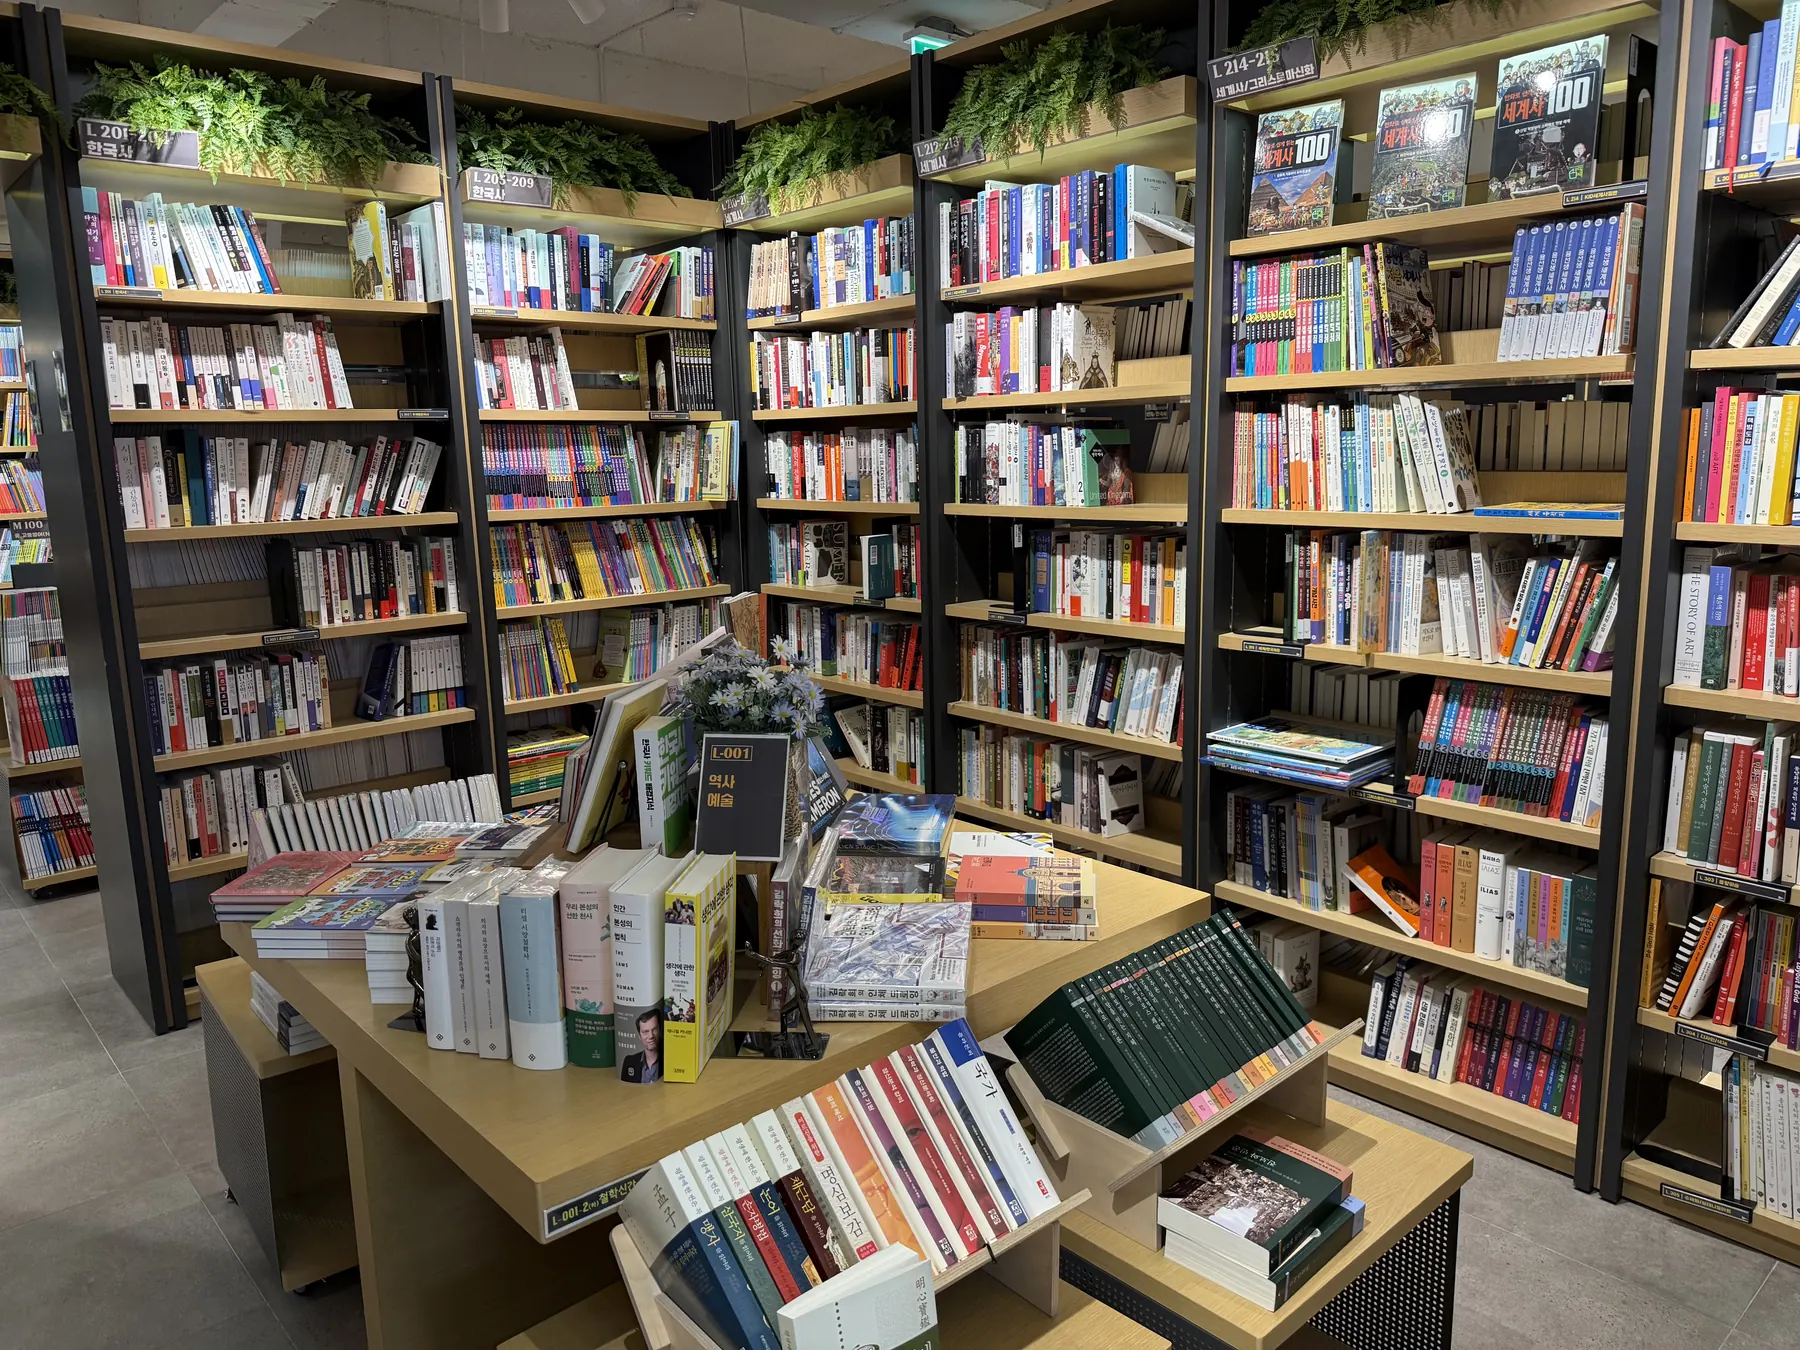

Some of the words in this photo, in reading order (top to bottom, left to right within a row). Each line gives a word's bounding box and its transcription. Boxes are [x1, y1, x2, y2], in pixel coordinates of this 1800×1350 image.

[1212, 64, 1222, 79] L
[1503, 98, 1544, 123] 세계사
[1547, 77, 1589, 115] 100
[86, 124, 97, 136] L
[86, 141, 134, 158] 한국사
[916, 146, 924, 157] L
[1263, 149, 1294, 169] 세계사
[1296, 133, 1330, 164] 100
[919, 155, 947, 173] 세계사
[474, 172, 481, 182] L
[472, 186, 506, 200] 한국사
[1078, 481, 1083, 492] 2
[1089, 491, 1106, 500] United
[1107, 491, 1131, 501] Kingdom
[12, 521, 23, 530] M
[24, 520, 43, 530] 100
[833, 524, 845, 582] SUMER
[1690, 564, 1701, 585] THE
[1687, 587, 1699, 619] STORY
[1686, 621, 1696, 635] OF
[1684, 637, 1695, 656] ART
[642, 738, 651, 759] 한국사
[713, 747, 749, 759] L-001
[644, 760, 652, 782] 키워드
[709, 775, 735, 789] 역사
[645, 782, 654, 810] 배경지식
[707, 793, 734, 807] 예술
[811, 787, 840, 824] AMERON
[1480, 887, 1499, 896] ILIAS
[520, 908, 527, 921] 러셀
[566, 903, 578, 911] 우리
[579, 903, 599, 911] 본성의
[613, 904, 626, 913] 인간
[566, 912, 579, 920] 선한
[580, 912, 592, 920] 천사
[613, 919, 633, 928] 본성의
[614, 933, 627, 942] 법칙
[665, 962, 682, 970] 생각에
[683, 962, 695, 971] 관한
[827, 1006, 864, 1019] 김락희의
[868, 1009, 887, 1018] 인체
[890, 1009, 919, 1018] 드로잉
[881, 1066, 898, 1091] 정신분석
[893, 1090, 904, 1103] 강의
[969, 1060, 999, 1101] 국가
[853, 1078, 868, 1099] 종교의
[864, 1098, 875, 1111] 기원
[825, 1094, 836, 1108] 꿈의
[832, 1107, 843, 1121] 해석
[733, 1136, 749, 1158] 평생에
[747, 1162, 759, 1177] 번은
[755, 1186, 780, 1216] 논어
[764, 1124, 781, 1145] 평생에
[778, 1150, 791, 1165] 번은
[786, 1173, 817, 1215] 채근담
[694, 1154, 711, 1175] 평생에
[708, 1180, 722, 1196] 번은
[718, 1204, 746, 1241] 삼국지
[715, 1147, 731, 1167] 평생에
[729, 1172, 742, 1188] 번은
[738, 1197, 769, 1241] 손자병법
[818, 1165, 866, 1240] 명심보감
[671, 1166, 688, 1187] 평생에
[686, 1192, 699, 1208] 번은
[696, 1217, 720, 1248] 맹자
